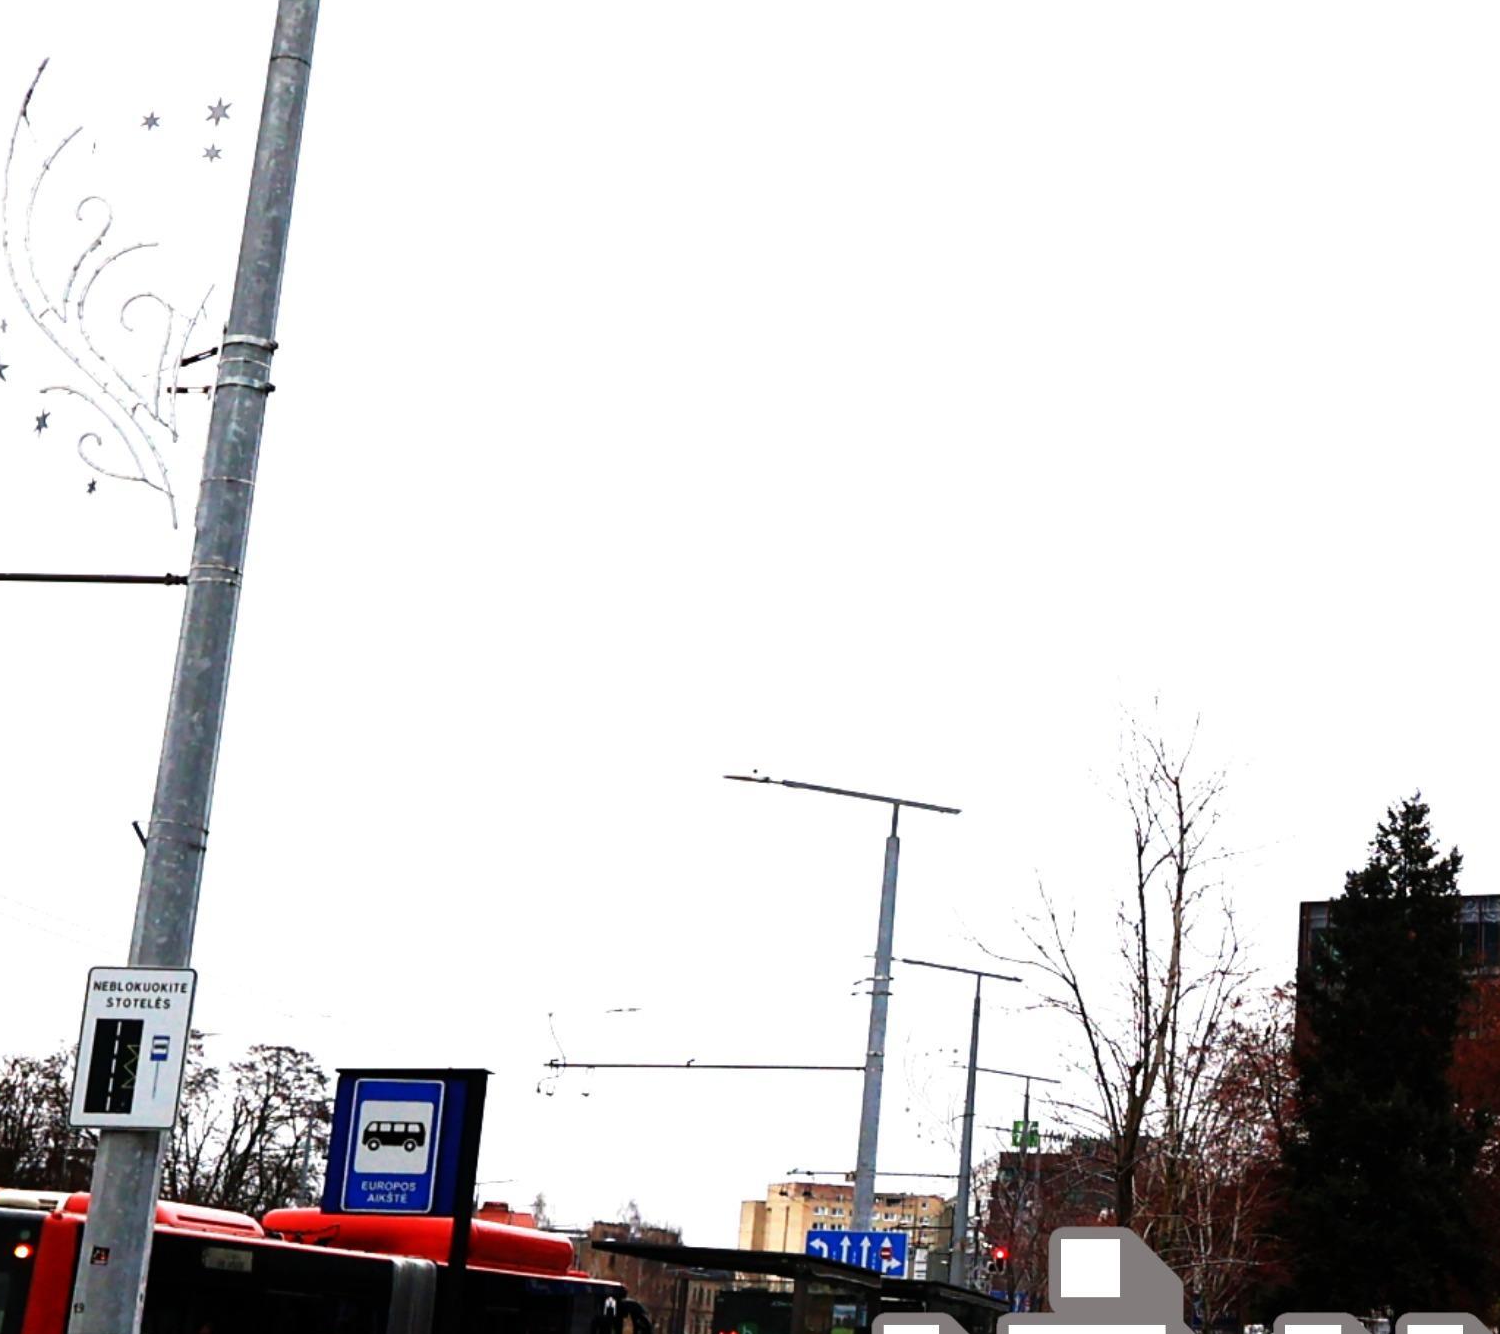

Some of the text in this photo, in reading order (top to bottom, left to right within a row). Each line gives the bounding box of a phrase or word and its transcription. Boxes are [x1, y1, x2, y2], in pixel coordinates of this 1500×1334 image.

[93, 980, 188, 994] NEBLOKUOKITE
[106, 995, 171, 1010] STOTELĖS
[361, 1180, 417, 1192] EUROPOS
[366, 1192, 408, 1204] AIKŠTĖ
